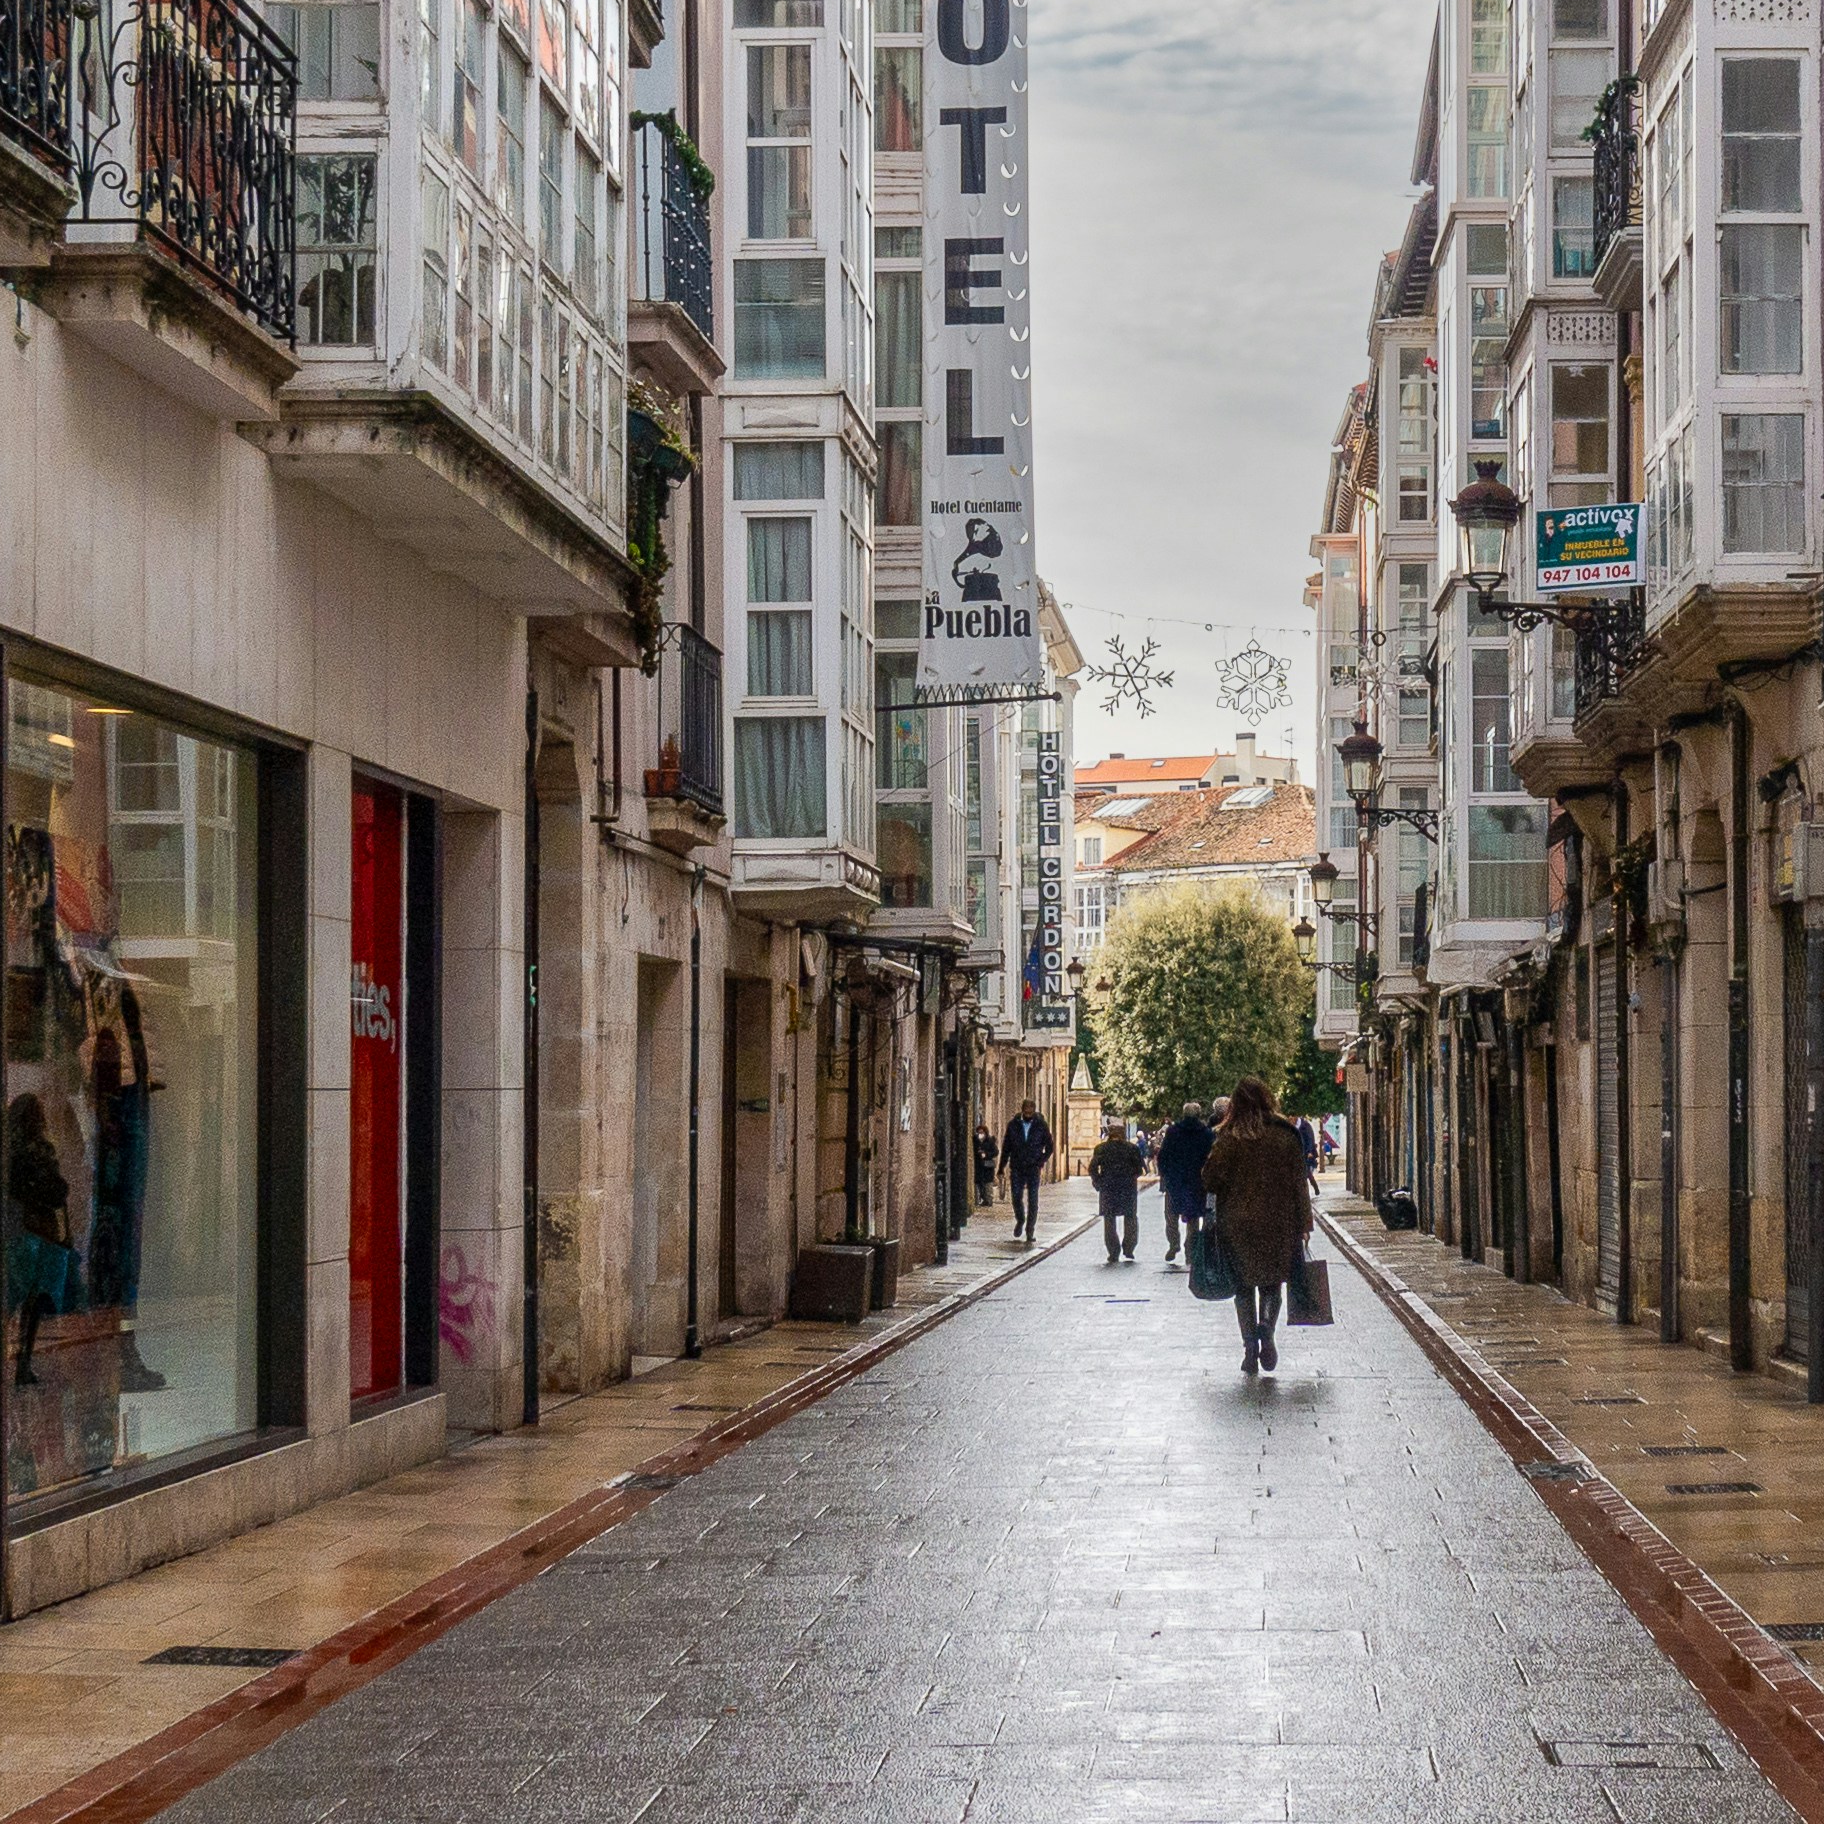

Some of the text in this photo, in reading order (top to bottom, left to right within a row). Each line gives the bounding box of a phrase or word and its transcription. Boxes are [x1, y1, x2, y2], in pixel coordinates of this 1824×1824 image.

[931, 498, 1022, 514] Hotel Cuéntame
[1565, 508, 1635, 527] activox
[1565, 538, 1625, 550] INMUEBLE EN
[1560, 548, 1629, 561] SU VECINDARIO
[1543, 564, 1630, 583] 947 104 104
[925, 604, 1031, 639] Puebla
[1041, 733, 1060, 993] HOTEL CORDON
